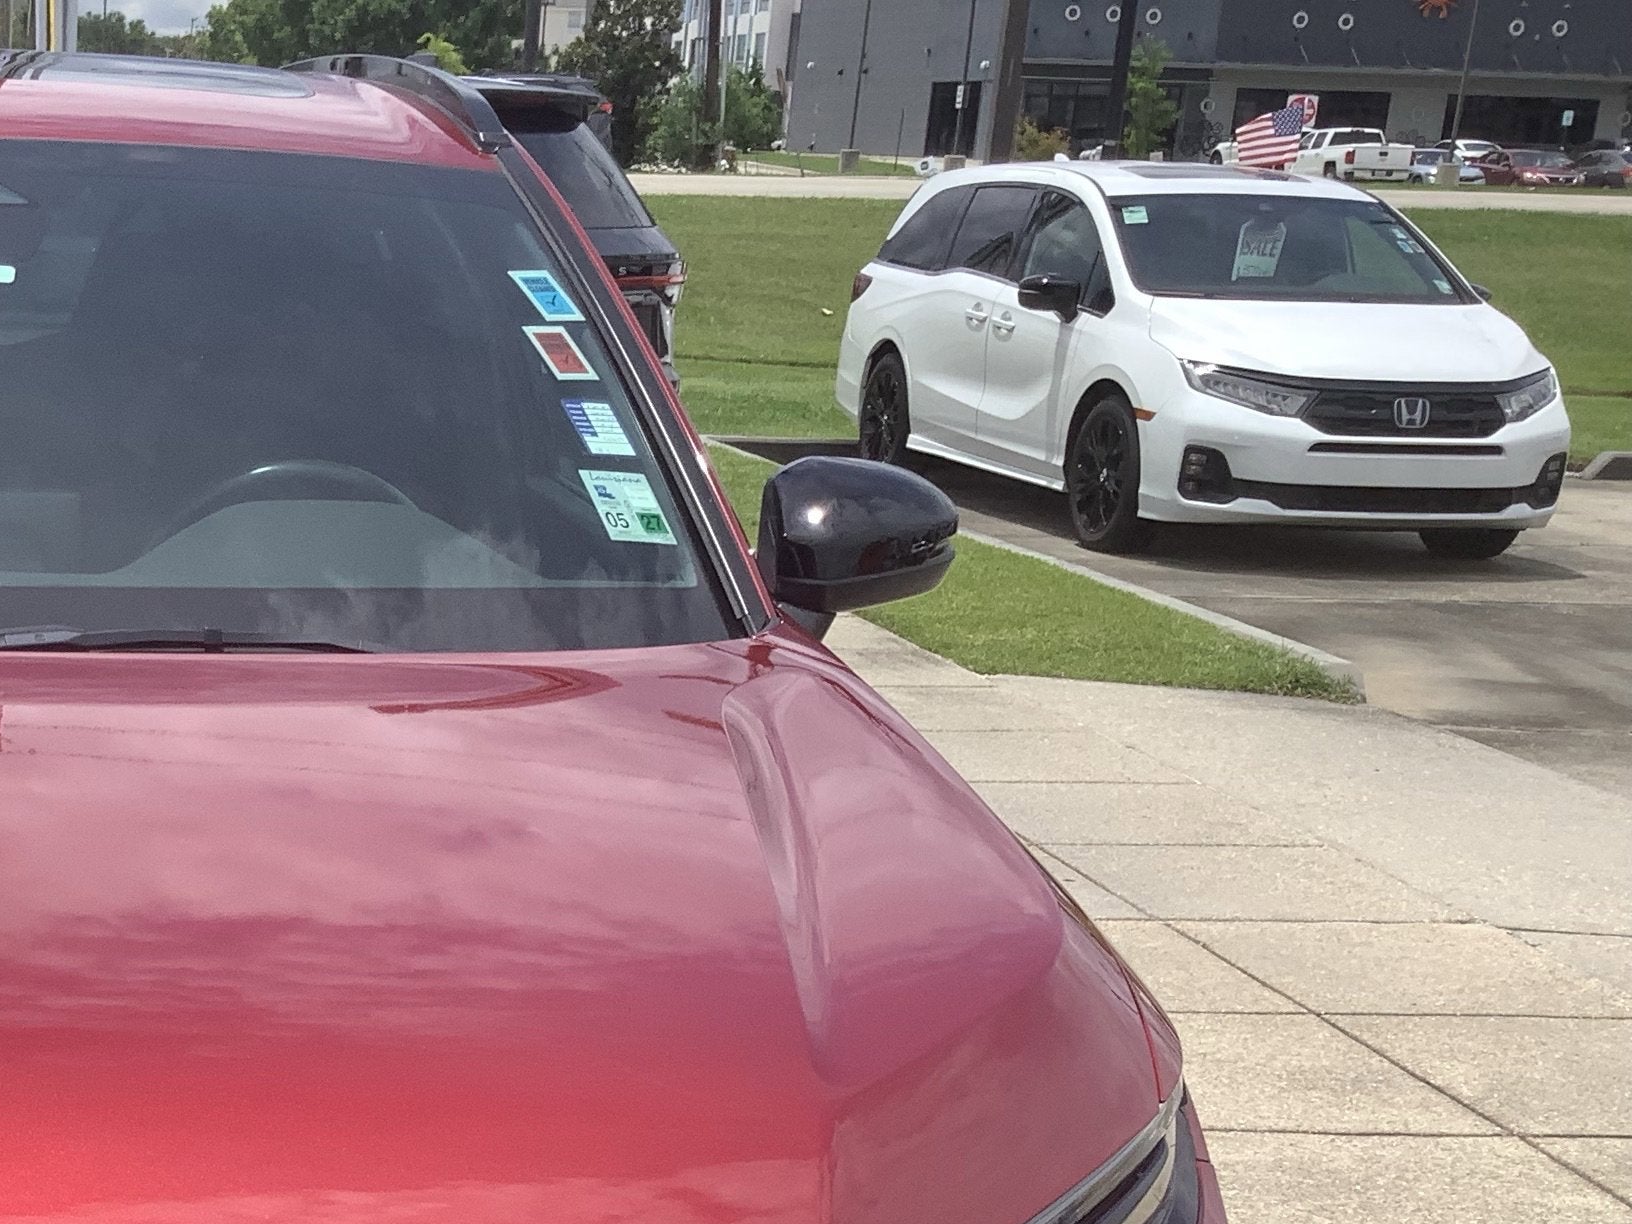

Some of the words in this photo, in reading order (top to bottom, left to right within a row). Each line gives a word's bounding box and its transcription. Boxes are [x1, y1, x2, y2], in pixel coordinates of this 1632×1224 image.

[1240, 238, 1282, 257] SALE
[588, 471, 643, 484] Louisiana
[605, 511, 630, 529] 05
[640, 514, 664, 531] 27
